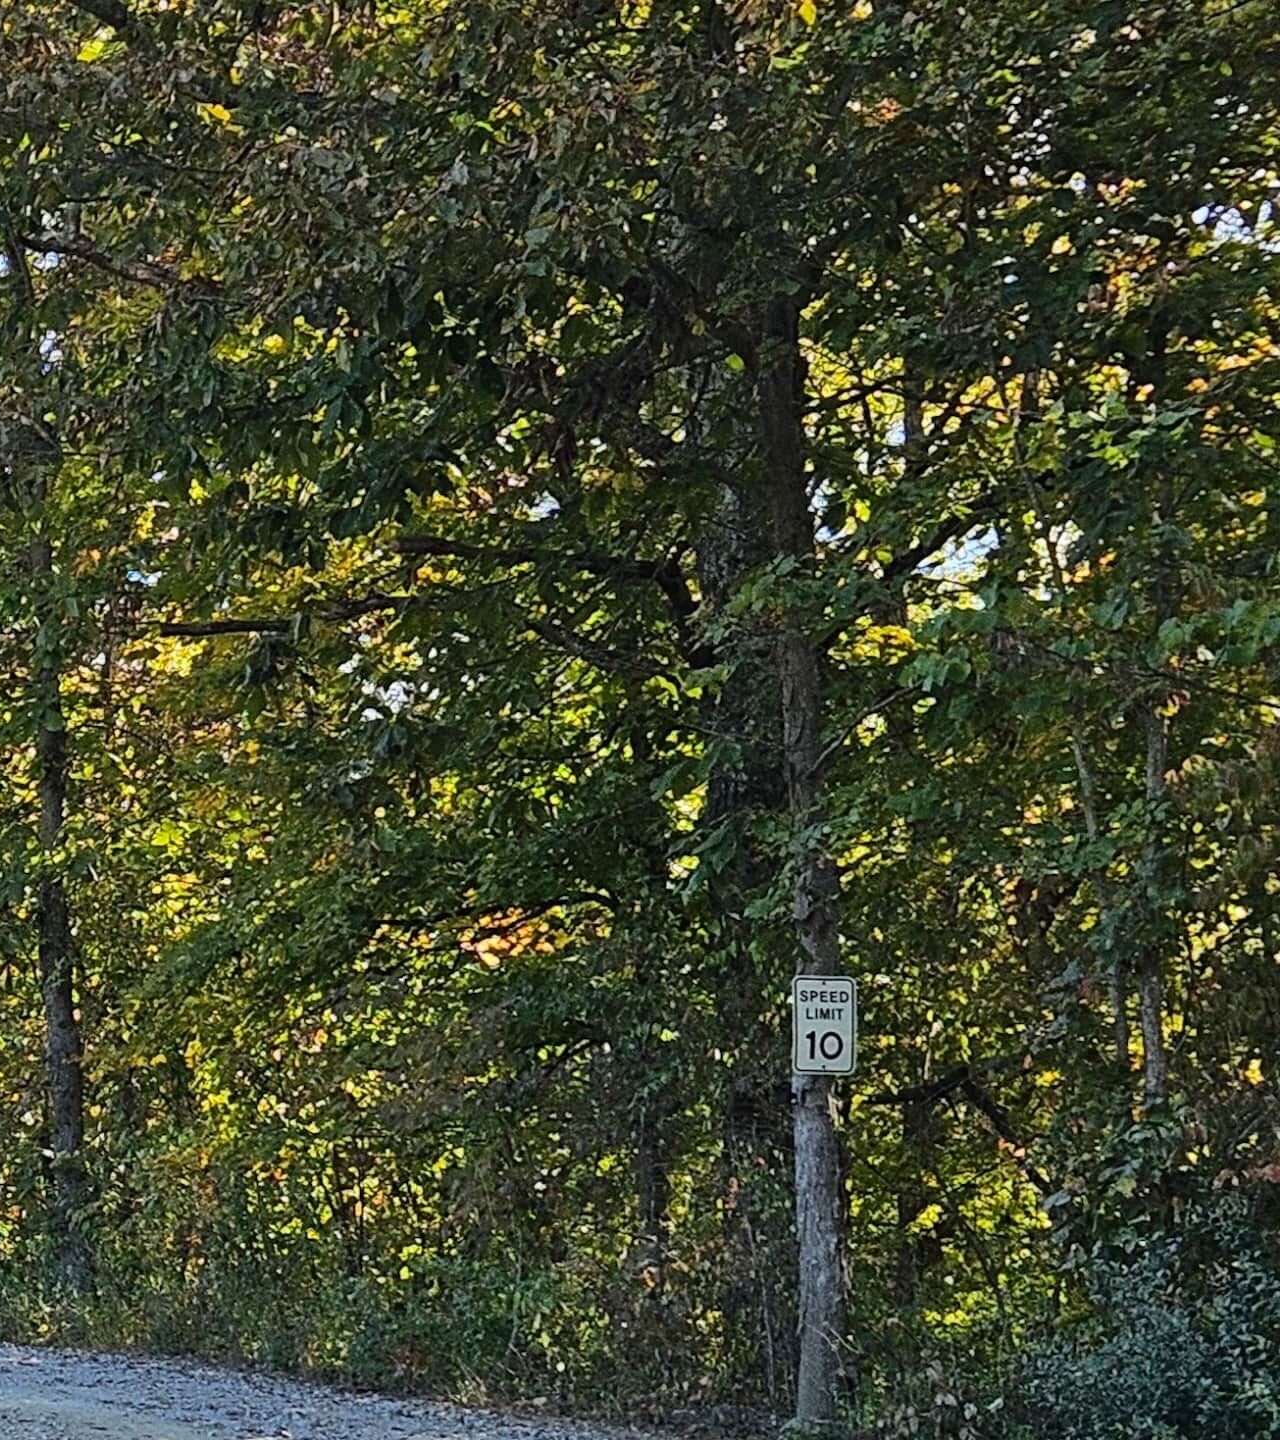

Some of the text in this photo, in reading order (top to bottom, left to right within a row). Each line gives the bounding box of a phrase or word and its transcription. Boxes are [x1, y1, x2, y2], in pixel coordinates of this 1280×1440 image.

[799, 990, 849, 1003] SPEED
[806, 1007, 844, 1020] LIMIT
[805, 1030, 844, 1060] 10
